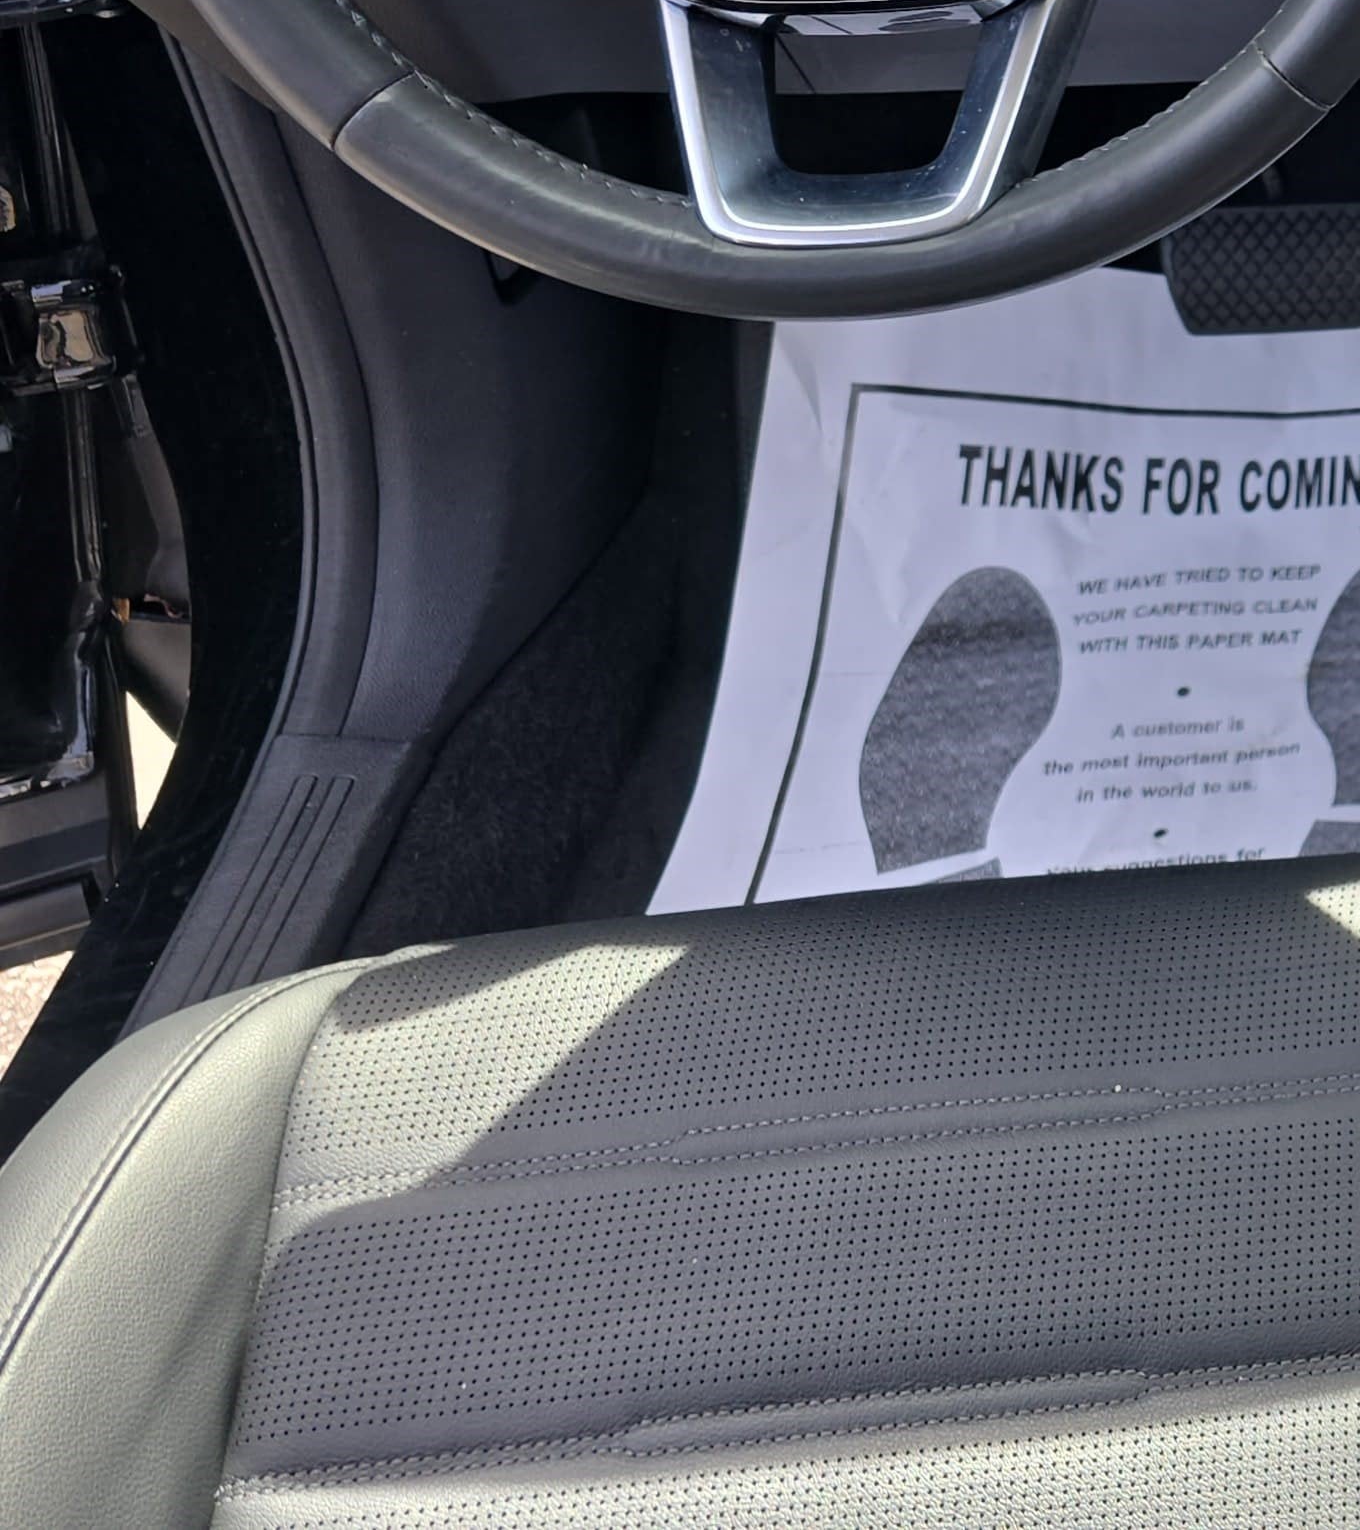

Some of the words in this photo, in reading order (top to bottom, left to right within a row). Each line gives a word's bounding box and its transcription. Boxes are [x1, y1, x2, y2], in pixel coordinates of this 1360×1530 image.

[958, 444, 1123, 513] THANKS
[1142, 458, 1221, 516] FOR
[1078, 578, 1107, 596] WE
[1114, 573, 1167, 592] HAVE
[1175, 566, 1231, 584] TRIED
[1238, 567, 1264, 583] TO
[1269, 564, 1322, 582] KEEP
[1072, 607, 1127, 627] YOUR
[1132, 600, 1246, 619] CARPETING
[1252, 597, 1319, 615] CLEAN
[1078, 635, 1128, 654] WITH
[1136, 633, 1181, 651] THIS
[1187, 631, 1254, 649] PAPER
[1259, 628, 1303, 646] MAT
[1111, 723, 1125, 739] A
[1133, 721, 1222, 738] customer
[1228, 716, 1245, 732] is
[1042, 759, 1074, 777] the
[1081, 755, 1129, 772] most
[1137, 751, 1228, 772] important
[1235, 742, 1301, 764] person
[1077, 786, 1094, 803] in
[1103, 784, 1133, 800] the
[1141, 781, 1195, 799] world
[1203, 780, 1222, 796] to
[1229, 779, 1258, 794] us.
[1237, 847, 1265, 862] for
